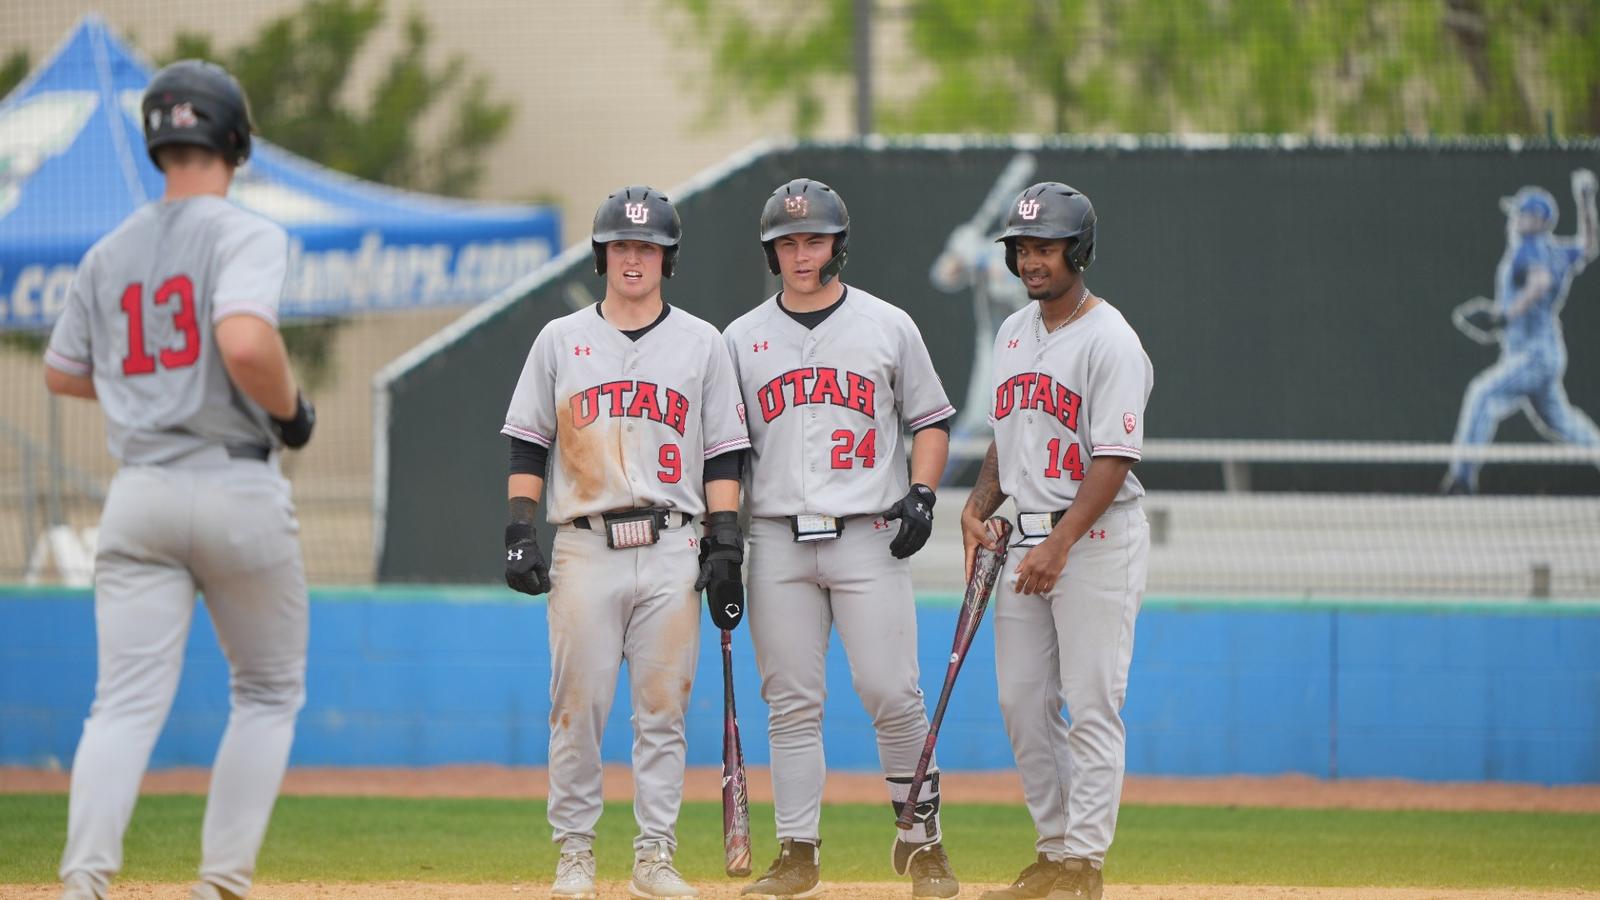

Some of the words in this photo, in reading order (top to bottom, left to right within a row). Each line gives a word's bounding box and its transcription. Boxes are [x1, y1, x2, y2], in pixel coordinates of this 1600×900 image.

[120, 275, 201, 376] 13
[569, 380, 689, 438] UTAH
[757, 367, 876, 424] UTAH
[995, 372, 1082, 434] UTAH
[657, 444, 682, 484] 9
[831, 429, 876, 469] 24
[1044, 438, 1085, 481] 14
